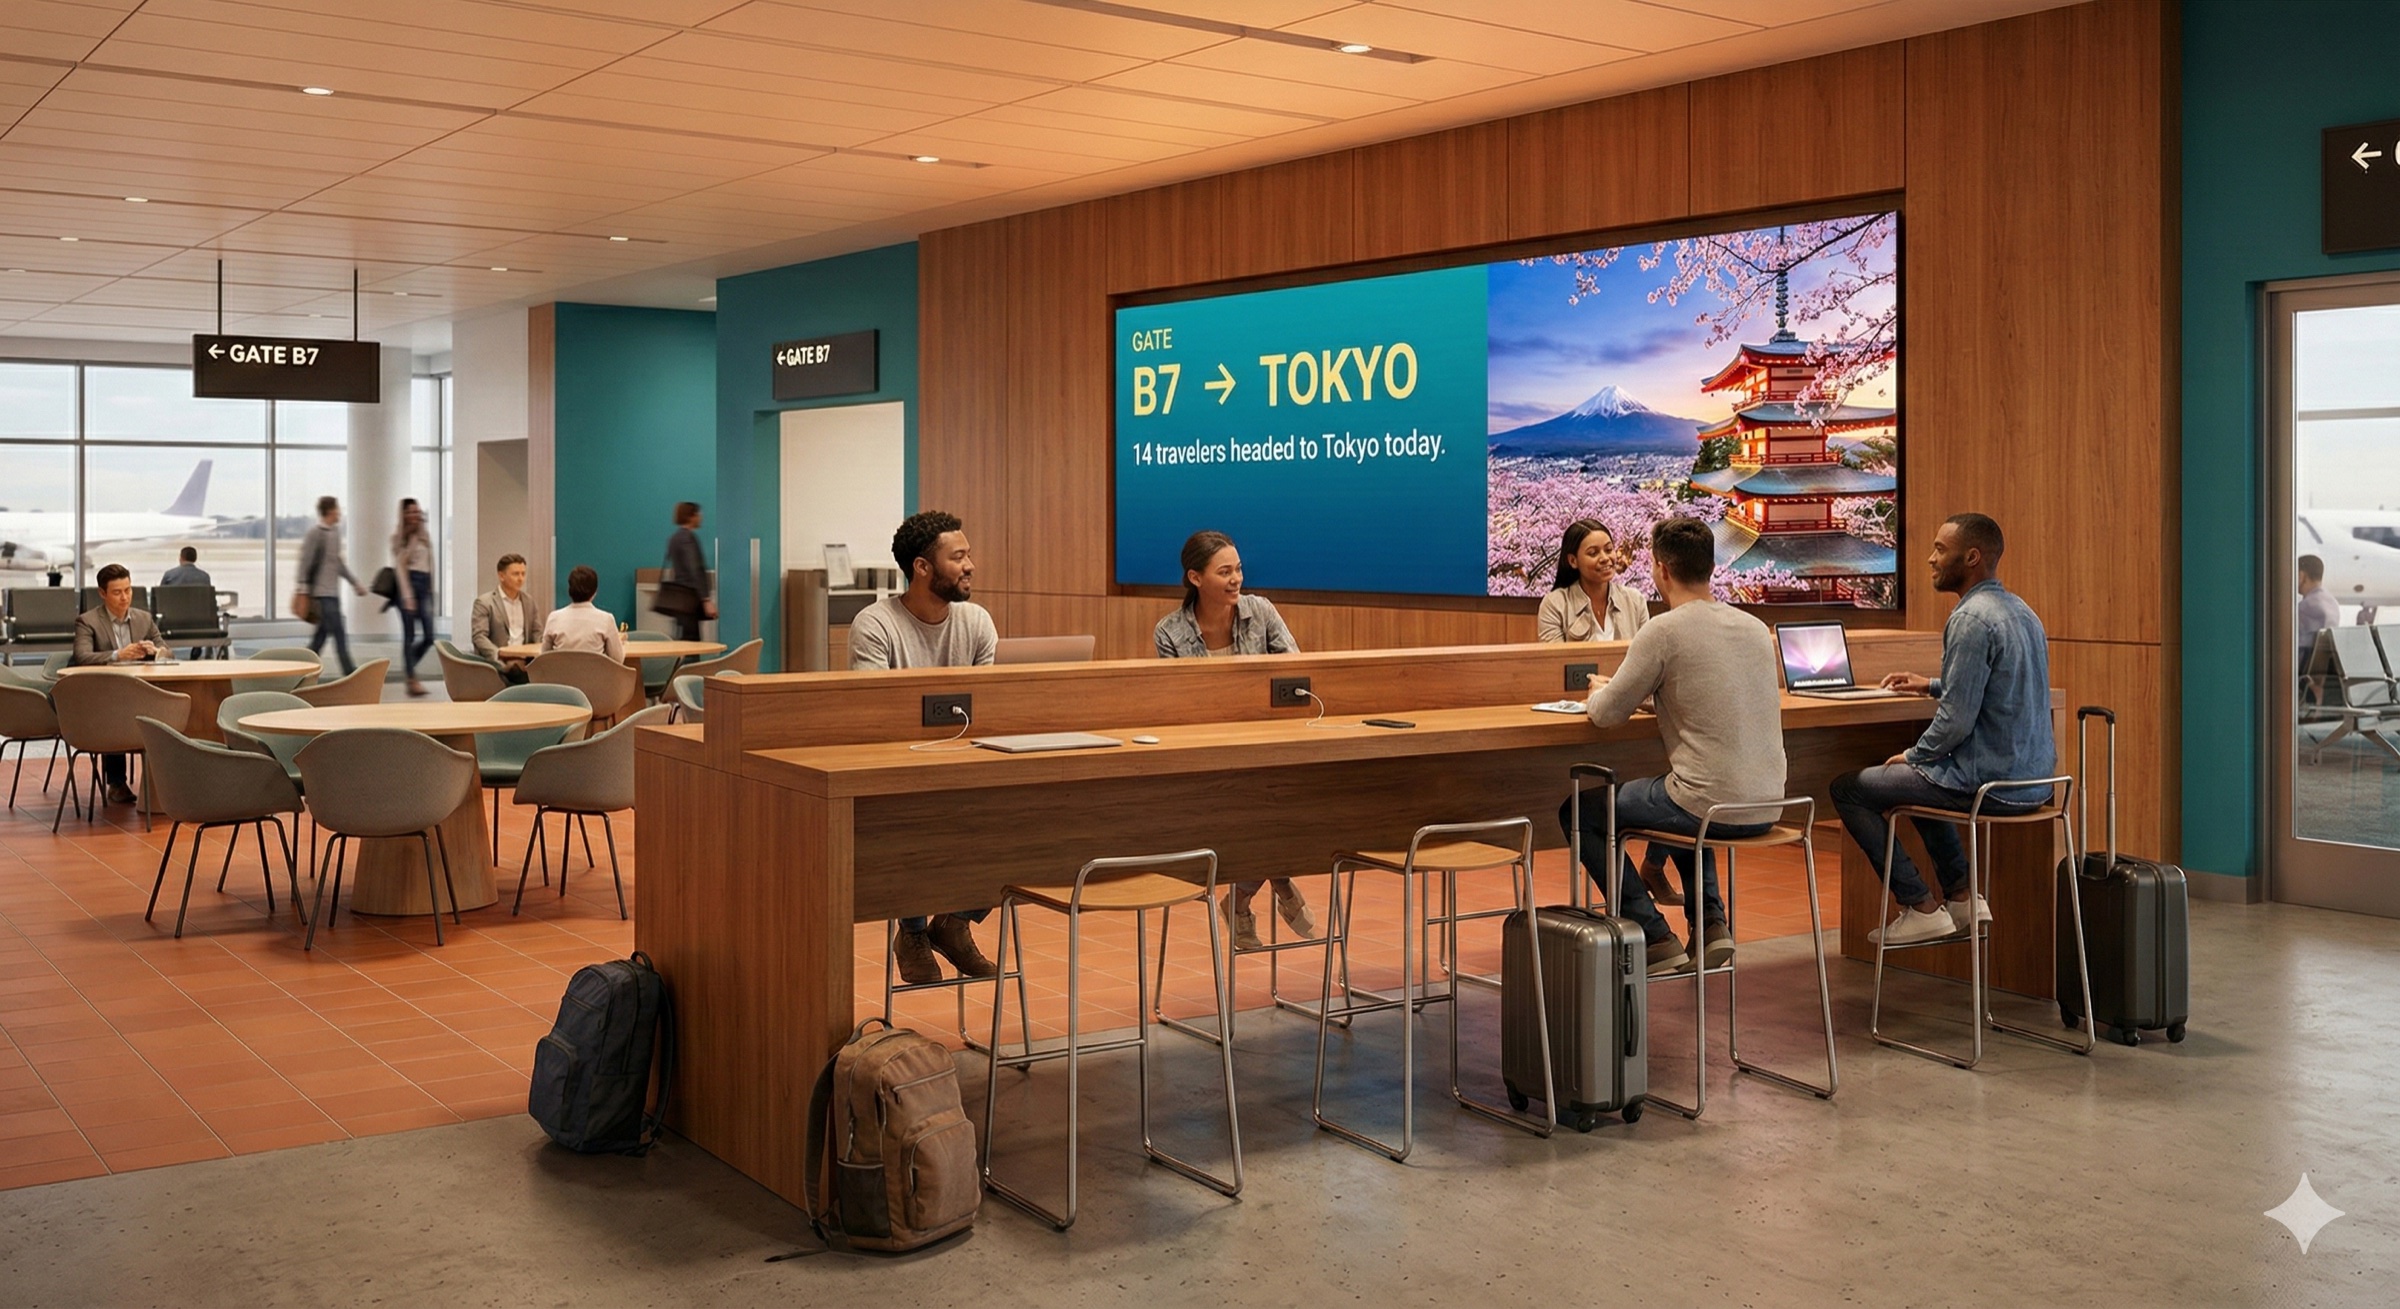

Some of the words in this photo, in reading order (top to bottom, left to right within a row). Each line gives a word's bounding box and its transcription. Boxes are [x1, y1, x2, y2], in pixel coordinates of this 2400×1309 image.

[1132, 328, 1173, 352] GATE
[229, 344, 287, 364] GATE
[292, 347, 319, 366] B7
[786, 346, 815, 367] GATE
[816, 344, 831, 363] B7
[1133, 363, 1181, 416] B7
[1259, 342, 1418, 407] TOKYO
[1133, 442, 1152, 466] 14
[1156, 438, 1226, 465] travelers
[1230, 435, 1295, 462] headed
[1300, 436, 1318, 460] to
[1322, 431, 1380, 464] Tokyo
[1384, 428, 1446, 462] today.
